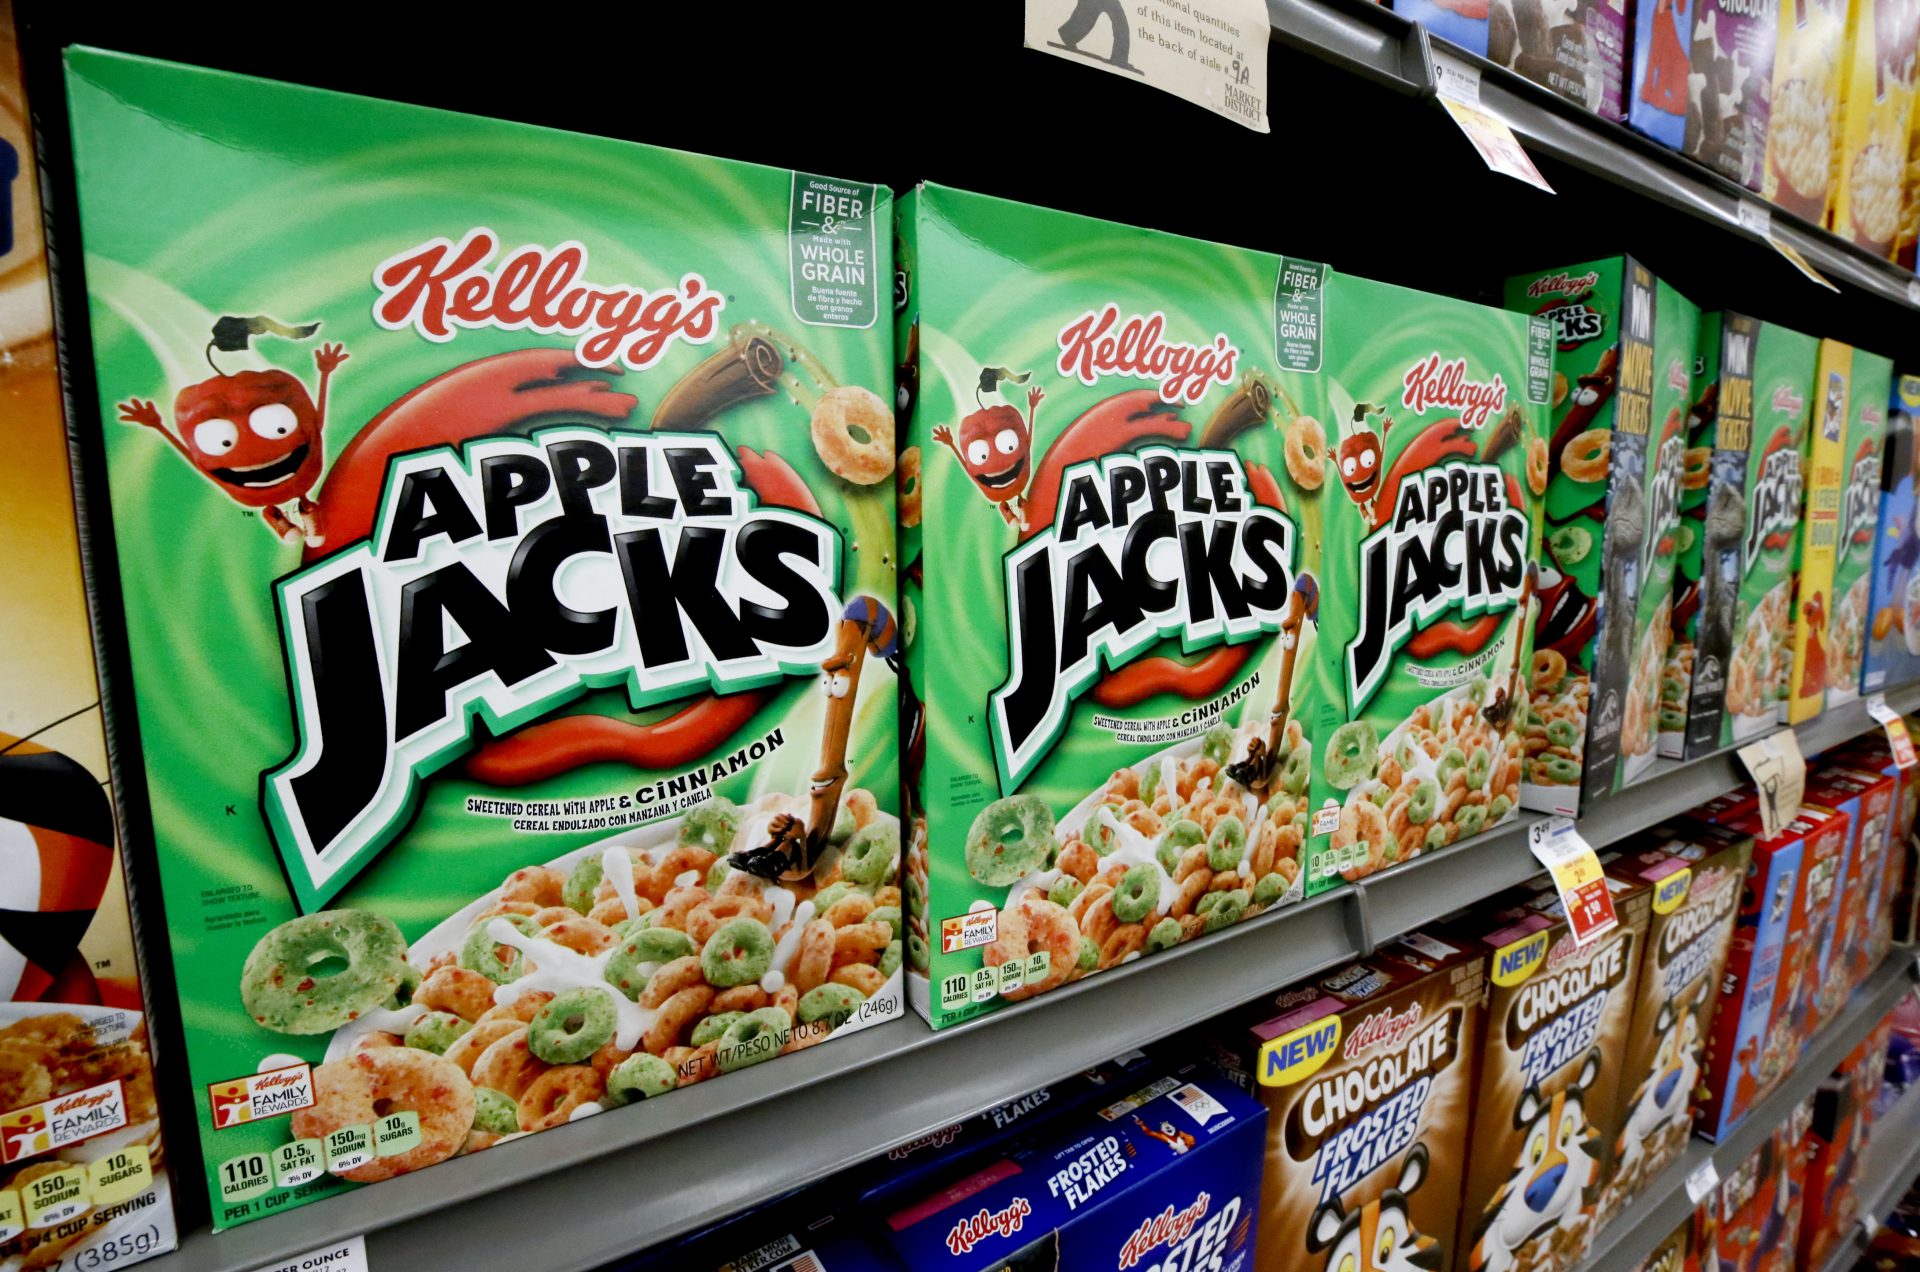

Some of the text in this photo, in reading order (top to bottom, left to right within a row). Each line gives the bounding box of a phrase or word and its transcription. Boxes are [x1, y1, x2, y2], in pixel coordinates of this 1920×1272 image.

[1137, 6, 1245, 61] of this item located at
[1193, 10, 1240, 38] quantities
[1138, 26, 1221, 72] the back of aisle
[1231, 60, 1251, 84] 9A
[1224, 83, 1261, 110] MARKET
[1224, 96, 1261, 122] DISTRICT
[809, 181, 828, 191] Good
[829, 184, 851, 195] Source
[801, 191, 863, 219] FIBER
[821, 216, 838, 235] &
[813, 234, 851, 245] Made with
[800, 244, 865, 266] WHOLE
[801, 262, 865, 286] GRAIN
[1283, 270, 1317, 291] FIBER
[1528, 272, 1599, 296] Kellogg's
[380, 232, 722, 366] Kellogg's
[807, 294, 817, 302] de
[818, 294, 834, 303] fibra
[841, 297, 863, 306] hecho
[812, 286, 857, 297] Buena fuente
[823, 312, 849, 321] enteros
[830, 306, 853, 314] granos
[1280, 309, 1317, 326] WHOLE
[1280, 323, 1317, 341] GRAIN
[1530, 326, 1551, 340] FIBER
[1060, 307, 1236, 400] Kellogg's
[1530, 355, 1549, 368] WHOLE
[1529, 366, 1549, 379] GRAIN
[1405, 355, 1505, 426] Kellogg's
[382, 439, 733, 562] APPLE
[1059, 456, 1242, 543] APPLE
[1394, 469, 1500, 534] APPLE
[1353, 510, 1523, 690] JACKS
[1003, 510, 1287, 754] JACKS
[289, 515, 831, 857] JACKS
[1093, 716, 1123, 730] SWEETENED
[1124, 721, 1142, 731] CEREAL
[1157, 719, 1171, 730] APPLE
[1172, 718, 1179, 728] &
[1117, 733, 1136, 742] CEREAL
[1137, 735, 1166, 743] ENDULZADO
[1166, 732, 1176, 741] CON
[1176, 727, 1199, 739] MANZANA
[1204, 715, 1221, 730] CANELA
[225, 805, 236, 815] K
[467, 798, 523, 817] SWEETENED
[526, 803, 560, 817] CEREAL
[589, 798, 616, 814] APPLE
[618, 794, 632, 809] &
[513, 788, 712, 832] CEREAL ENDULZADO CON MANZANA Y CANELA
[243, 884, 253, 892] TO
[964, 925, 994, 939] FAMILY
[964, 934, 994, 946] REWARDS
[1028, 965, 1047, 974] SUGARS
[1500, 940, 1544, 977] NEW!
[944, 976, 966, 995] 110
[974, 980, 994, 990] SAT FAT
[1002, 972, 1021, 982] SODIUM
[1516, 937, 1624, 1032] CHOCOLATE
[943, 992, 968, 1004] CALORIES
[115, 1012, 126, 1021] TO
[942, 1012, 956, 1023] PER
[1523, 990, 1607, 1067] FROSTED
[678, 995, 898, 1079] NET WT/PESO NETO 8.7 OZ (246g)
[1346, 1004, 1421, 1058] Kellogg's
[1267, 1024, 1337, 1077] NEW!
[1527, 1017, 1597, 1088] FLAKES
[254, 1072, 303, 1091] Kellogg's
[1302, 1014, 1449, 1137] CHOCOLATE
[52, 1088, 114, 1116] Kellogg's
[252, 1084, 307, 1108] FAMILY
[253, 1097, 309, 1116] REWARDS
[52, 1101, 119, 1135] FAMILY
[992, 1088, 1051, 1129] FLAKES
[53, 1115, 121, 1144] REWARDS
[380, 1126, 414, 1143] SUGARS
[1081, 1136, 1095, 1147] OPEN
[1317, 1081, 1431, 1179] FROSTED
[331, 1141, 366, 1157] SODIUM
[352, 1155, 363, 1165] DV
[1324, 1115, 1418, 1201] FLAKES
[99, 1164, 143, 1187] SUGARS
[224, 1156, 263, 1183] 110
[280, 1155, 316, 1172] SAT FAT
[1047, 1136, 1119, 1198] FROSTED
[224, 1175, 269, 1195] CALORIES
[288, 1171, 313, 1184] 3% DV
[1064, 1152, 1127, 1211] FLAKES
[33, 1187, 80, 1210] SODIUM
[224, 1191, 290, 1221] PER 1 CUP
[57, 1192, 156, 1239] CUP SERVING
[62, 1206, 75, 1216] DV
[948, 1199, 1029, 1252] Kellogg's
[1119, 1192, 1209, 1270] Kellogg's
[1146, 1196, 1241, 1272] STED
[74, 1224, 159, 1272] (385g)
[302, 1248, 350, 1270] OUNCE
[750, 1244, 793, 1272] KFR.COM
[762, 1237, 793, 1257] MORE
